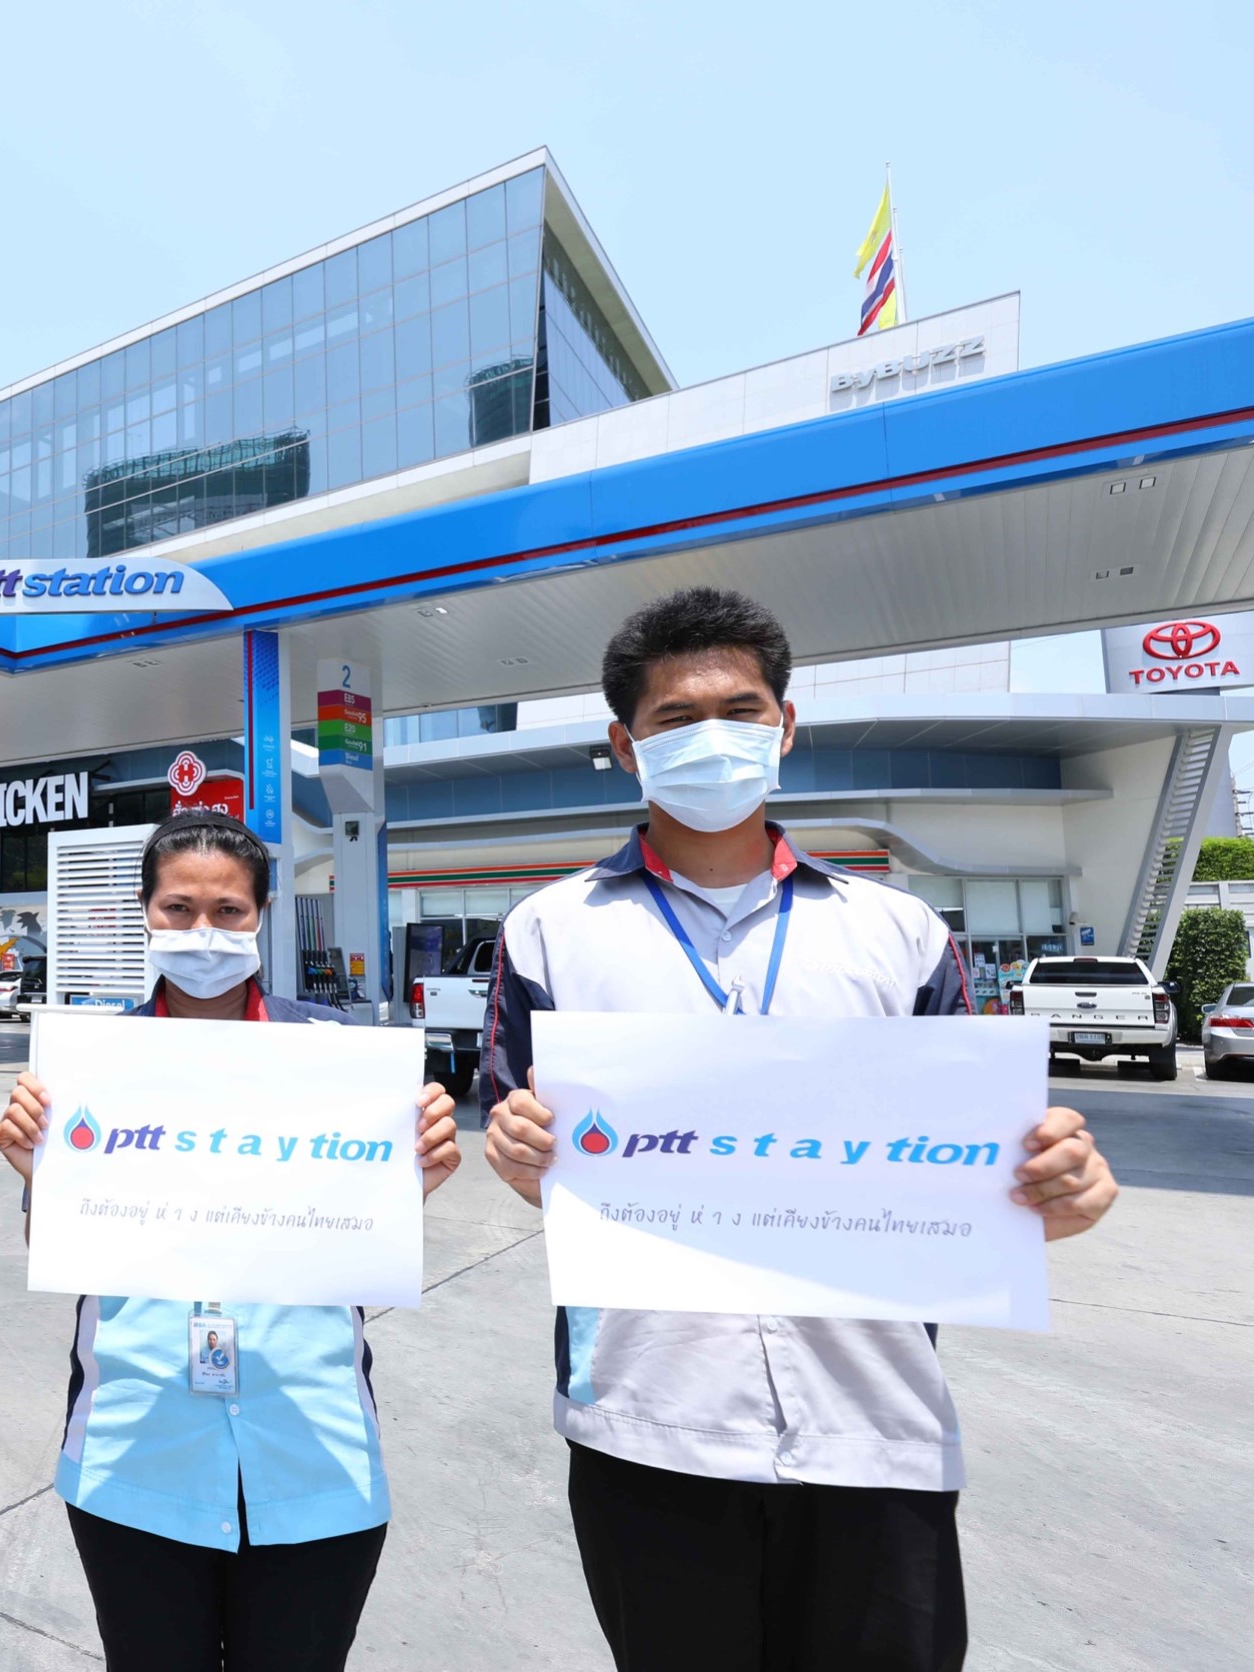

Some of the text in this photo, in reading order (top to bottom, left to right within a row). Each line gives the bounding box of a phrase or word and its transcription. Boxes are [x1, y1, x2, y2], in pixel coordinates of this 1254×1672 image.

[341, 665, 352, 688] 2
[1129, 661, 1240, 684] TOYOTA
[344, 723, 356, 733] E20
[357, 712, 367, 724] 95
[358, 742, 367, 752] 91
[104, 1123, 166, 1154] ptt
[622, 1129, 699, 1158] ptt
